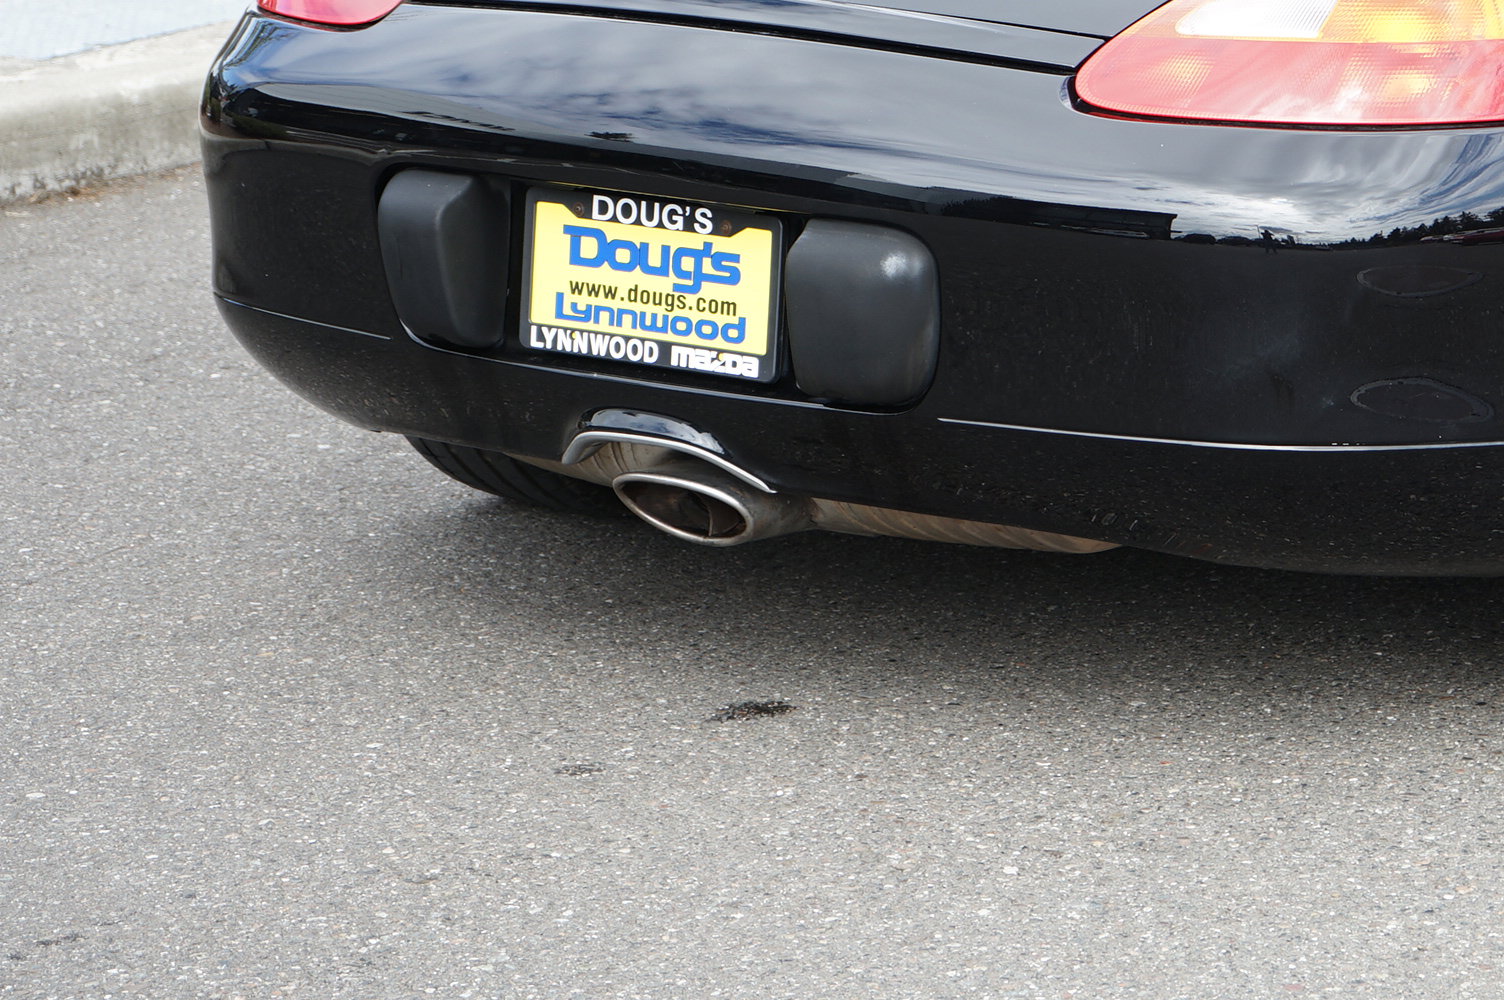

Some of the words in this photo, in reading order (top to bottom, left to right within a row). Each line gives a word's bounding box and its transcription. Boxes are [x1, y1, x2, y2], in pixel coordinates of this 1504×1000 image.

[591, 194, 713, 235] DOUG'S
[563, 224, 741, 295] Doug's
[555, 291, 747, 345] Lynnwood
[569, 280, 738, 317] www.dougs.com
[529, 325, 660, 364] LYNNWOOD
